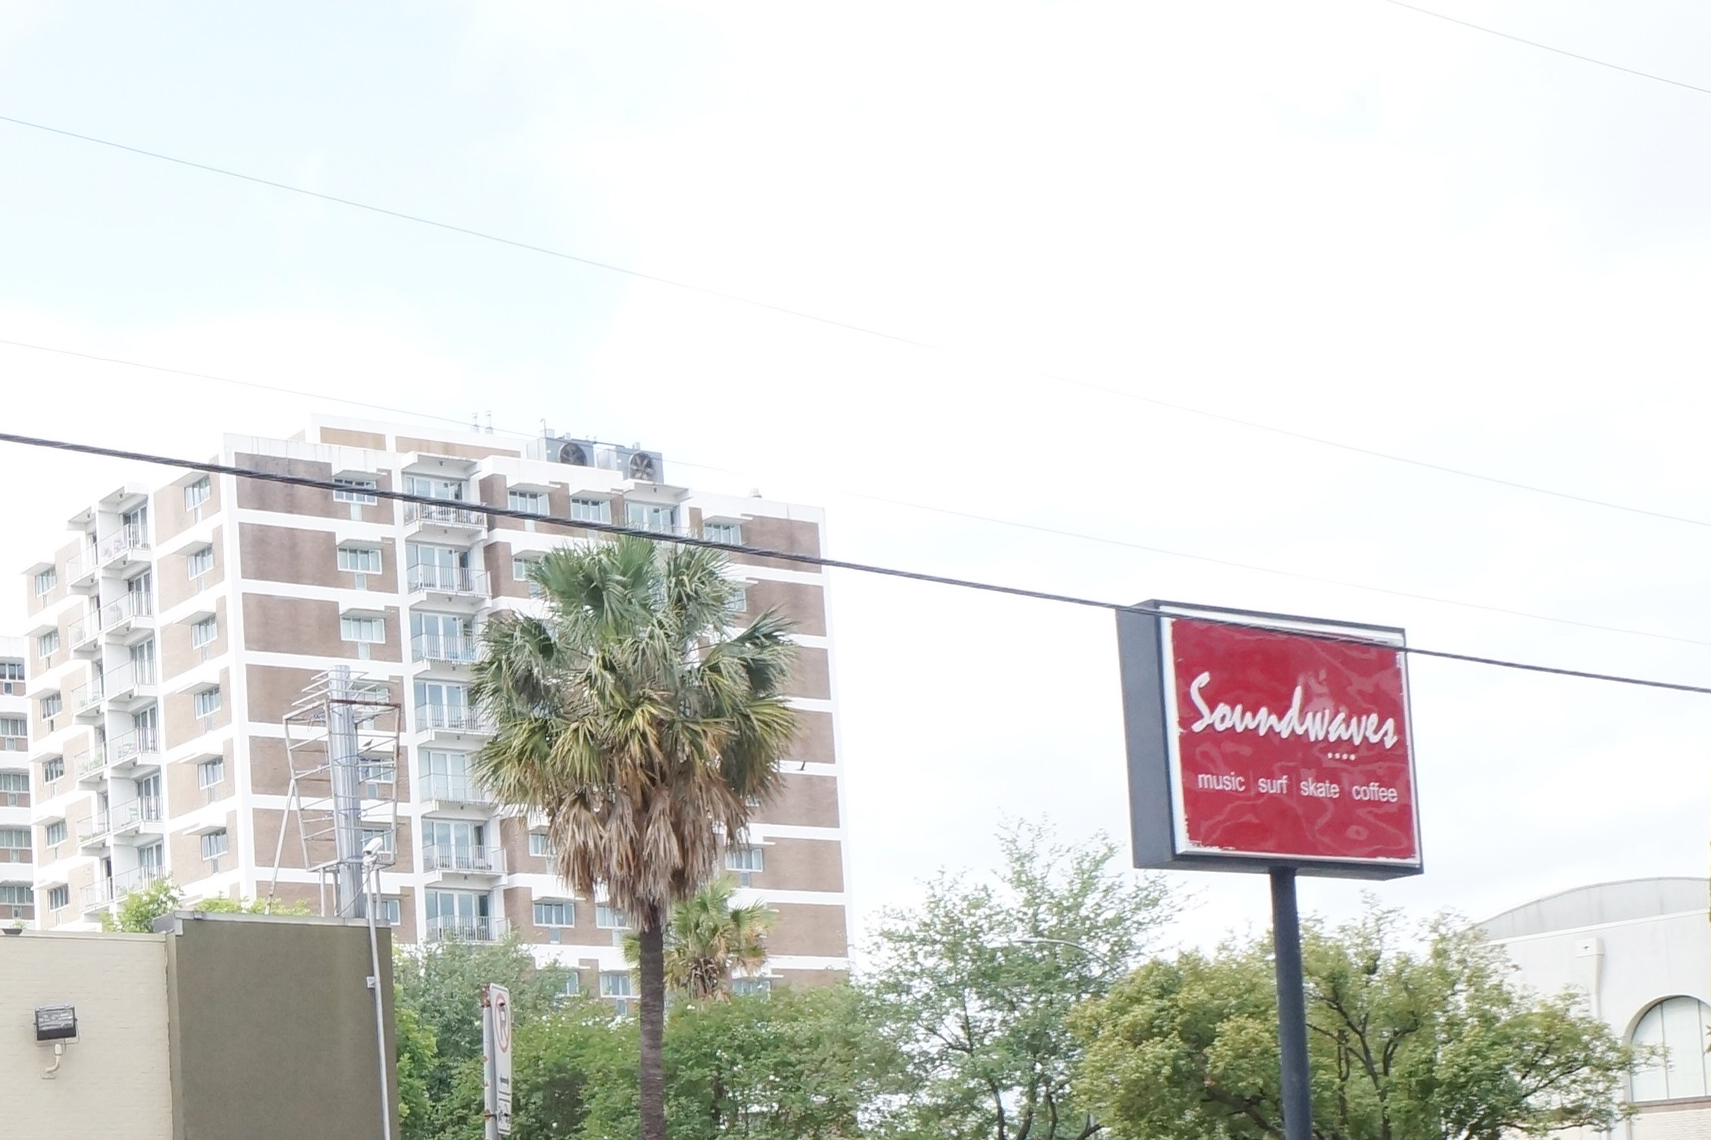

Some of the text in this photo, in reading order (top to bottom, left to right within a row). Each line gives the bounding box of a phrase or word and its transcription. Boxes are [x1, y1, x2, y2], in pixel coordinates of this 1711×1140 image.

[1189, 671, 1399, 750] Soundwaves
[1197, 772, 1398, 803] music surf skate coffee
